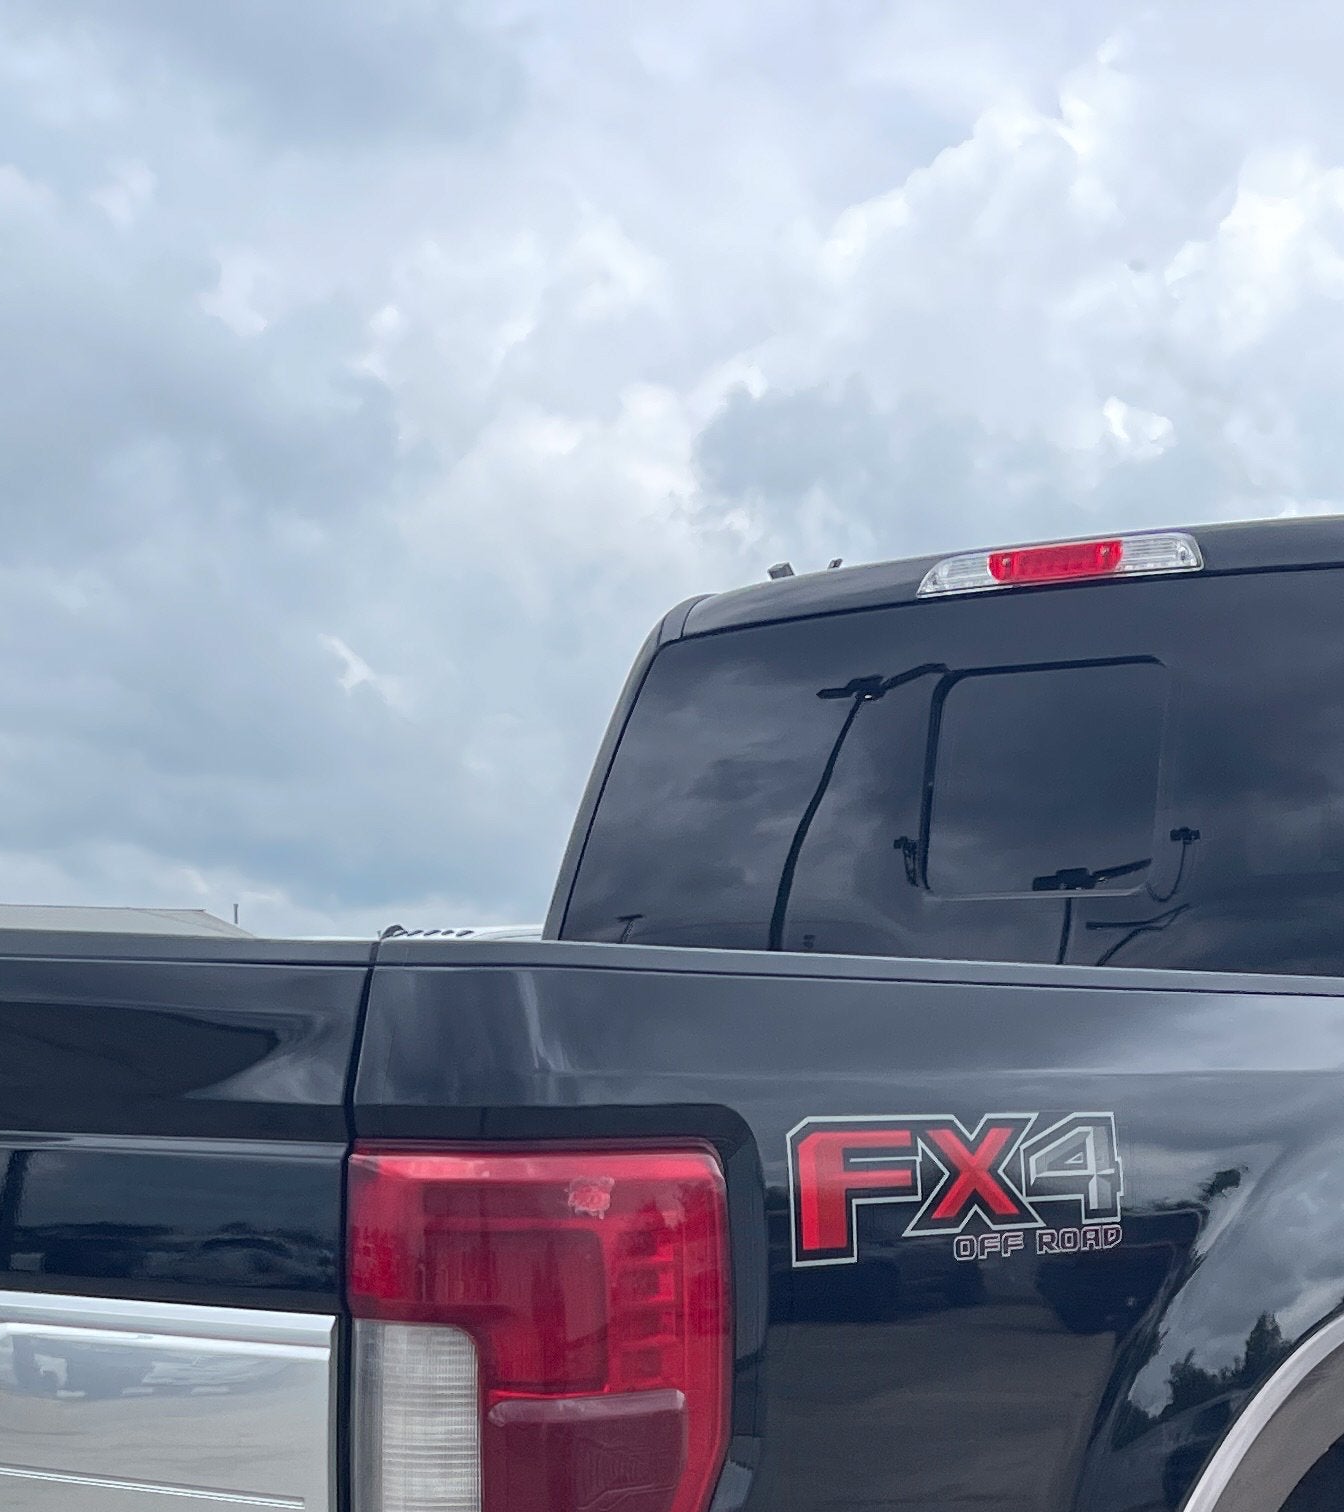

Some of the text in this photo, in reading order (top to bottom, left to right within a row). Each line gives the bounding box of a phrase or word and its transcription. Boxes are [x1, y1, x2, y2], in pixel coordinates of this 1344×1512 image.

[786, 1112, 1124, 1267] FX4
[954, 1224, 1123, 1261] OFF ROAD
